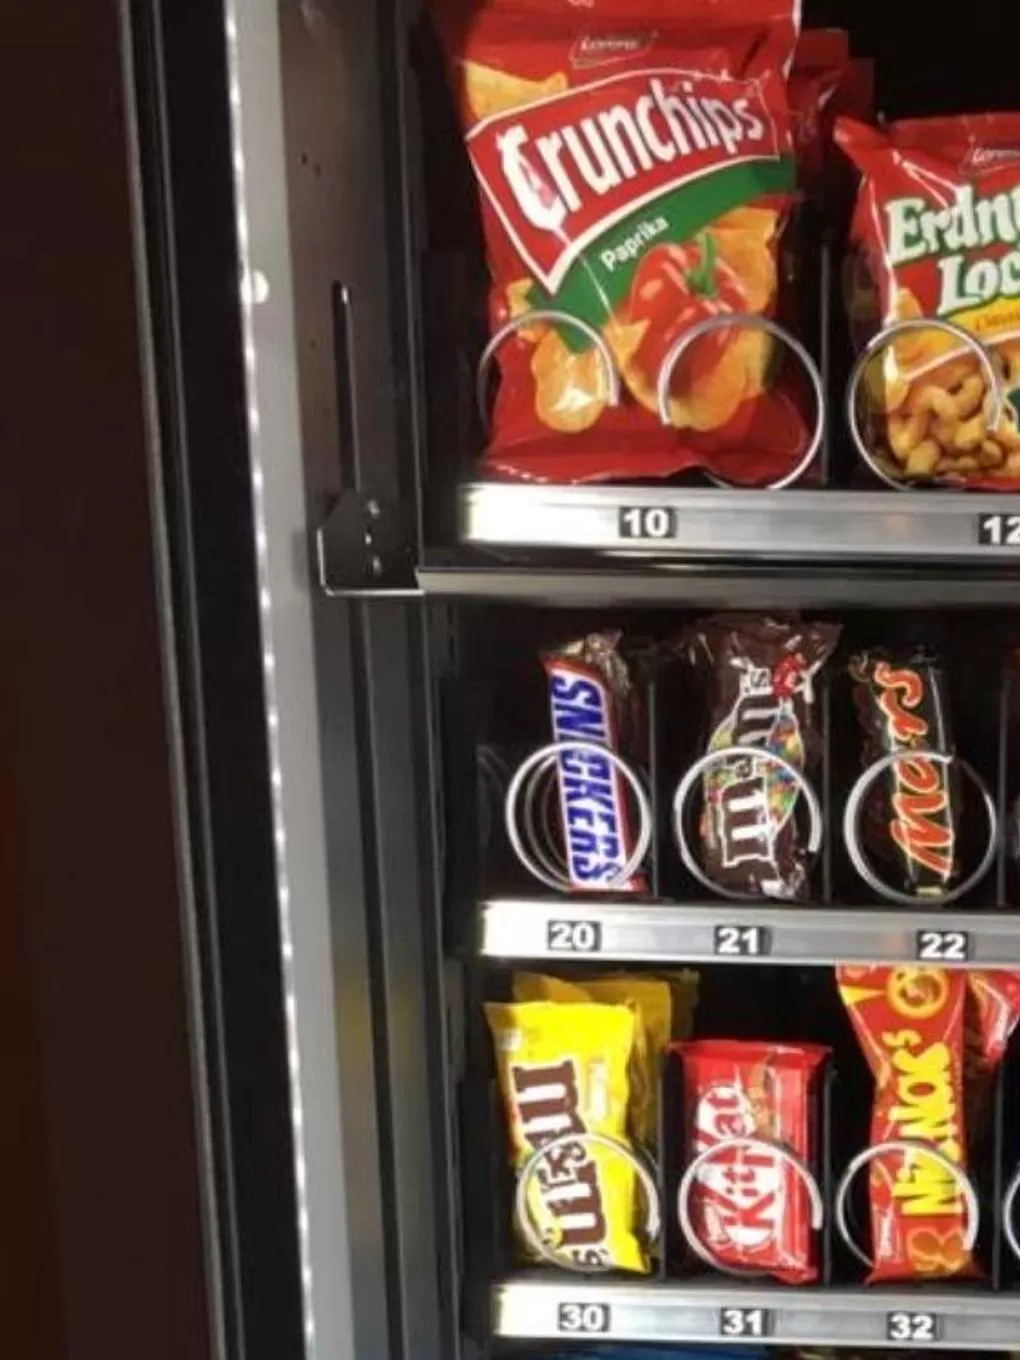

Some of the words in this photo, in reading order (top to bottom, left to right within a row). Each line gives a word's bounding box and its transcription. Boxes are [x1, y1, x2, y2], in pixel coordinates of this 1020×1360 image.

[496, 78, 764, 231] Crunchips
[600, 216, 669, 271] Paprika
[622, 509, 671, 538] 10
[550, 924, 595, 949] 20
[718, 928, 758, 953] 21
[920, 934, 966, 959] 22
[559, 1307, 603, 1330] 30
[724, 1311, 763, 1334] 31
[890, 1316, 934, 1340] 32
